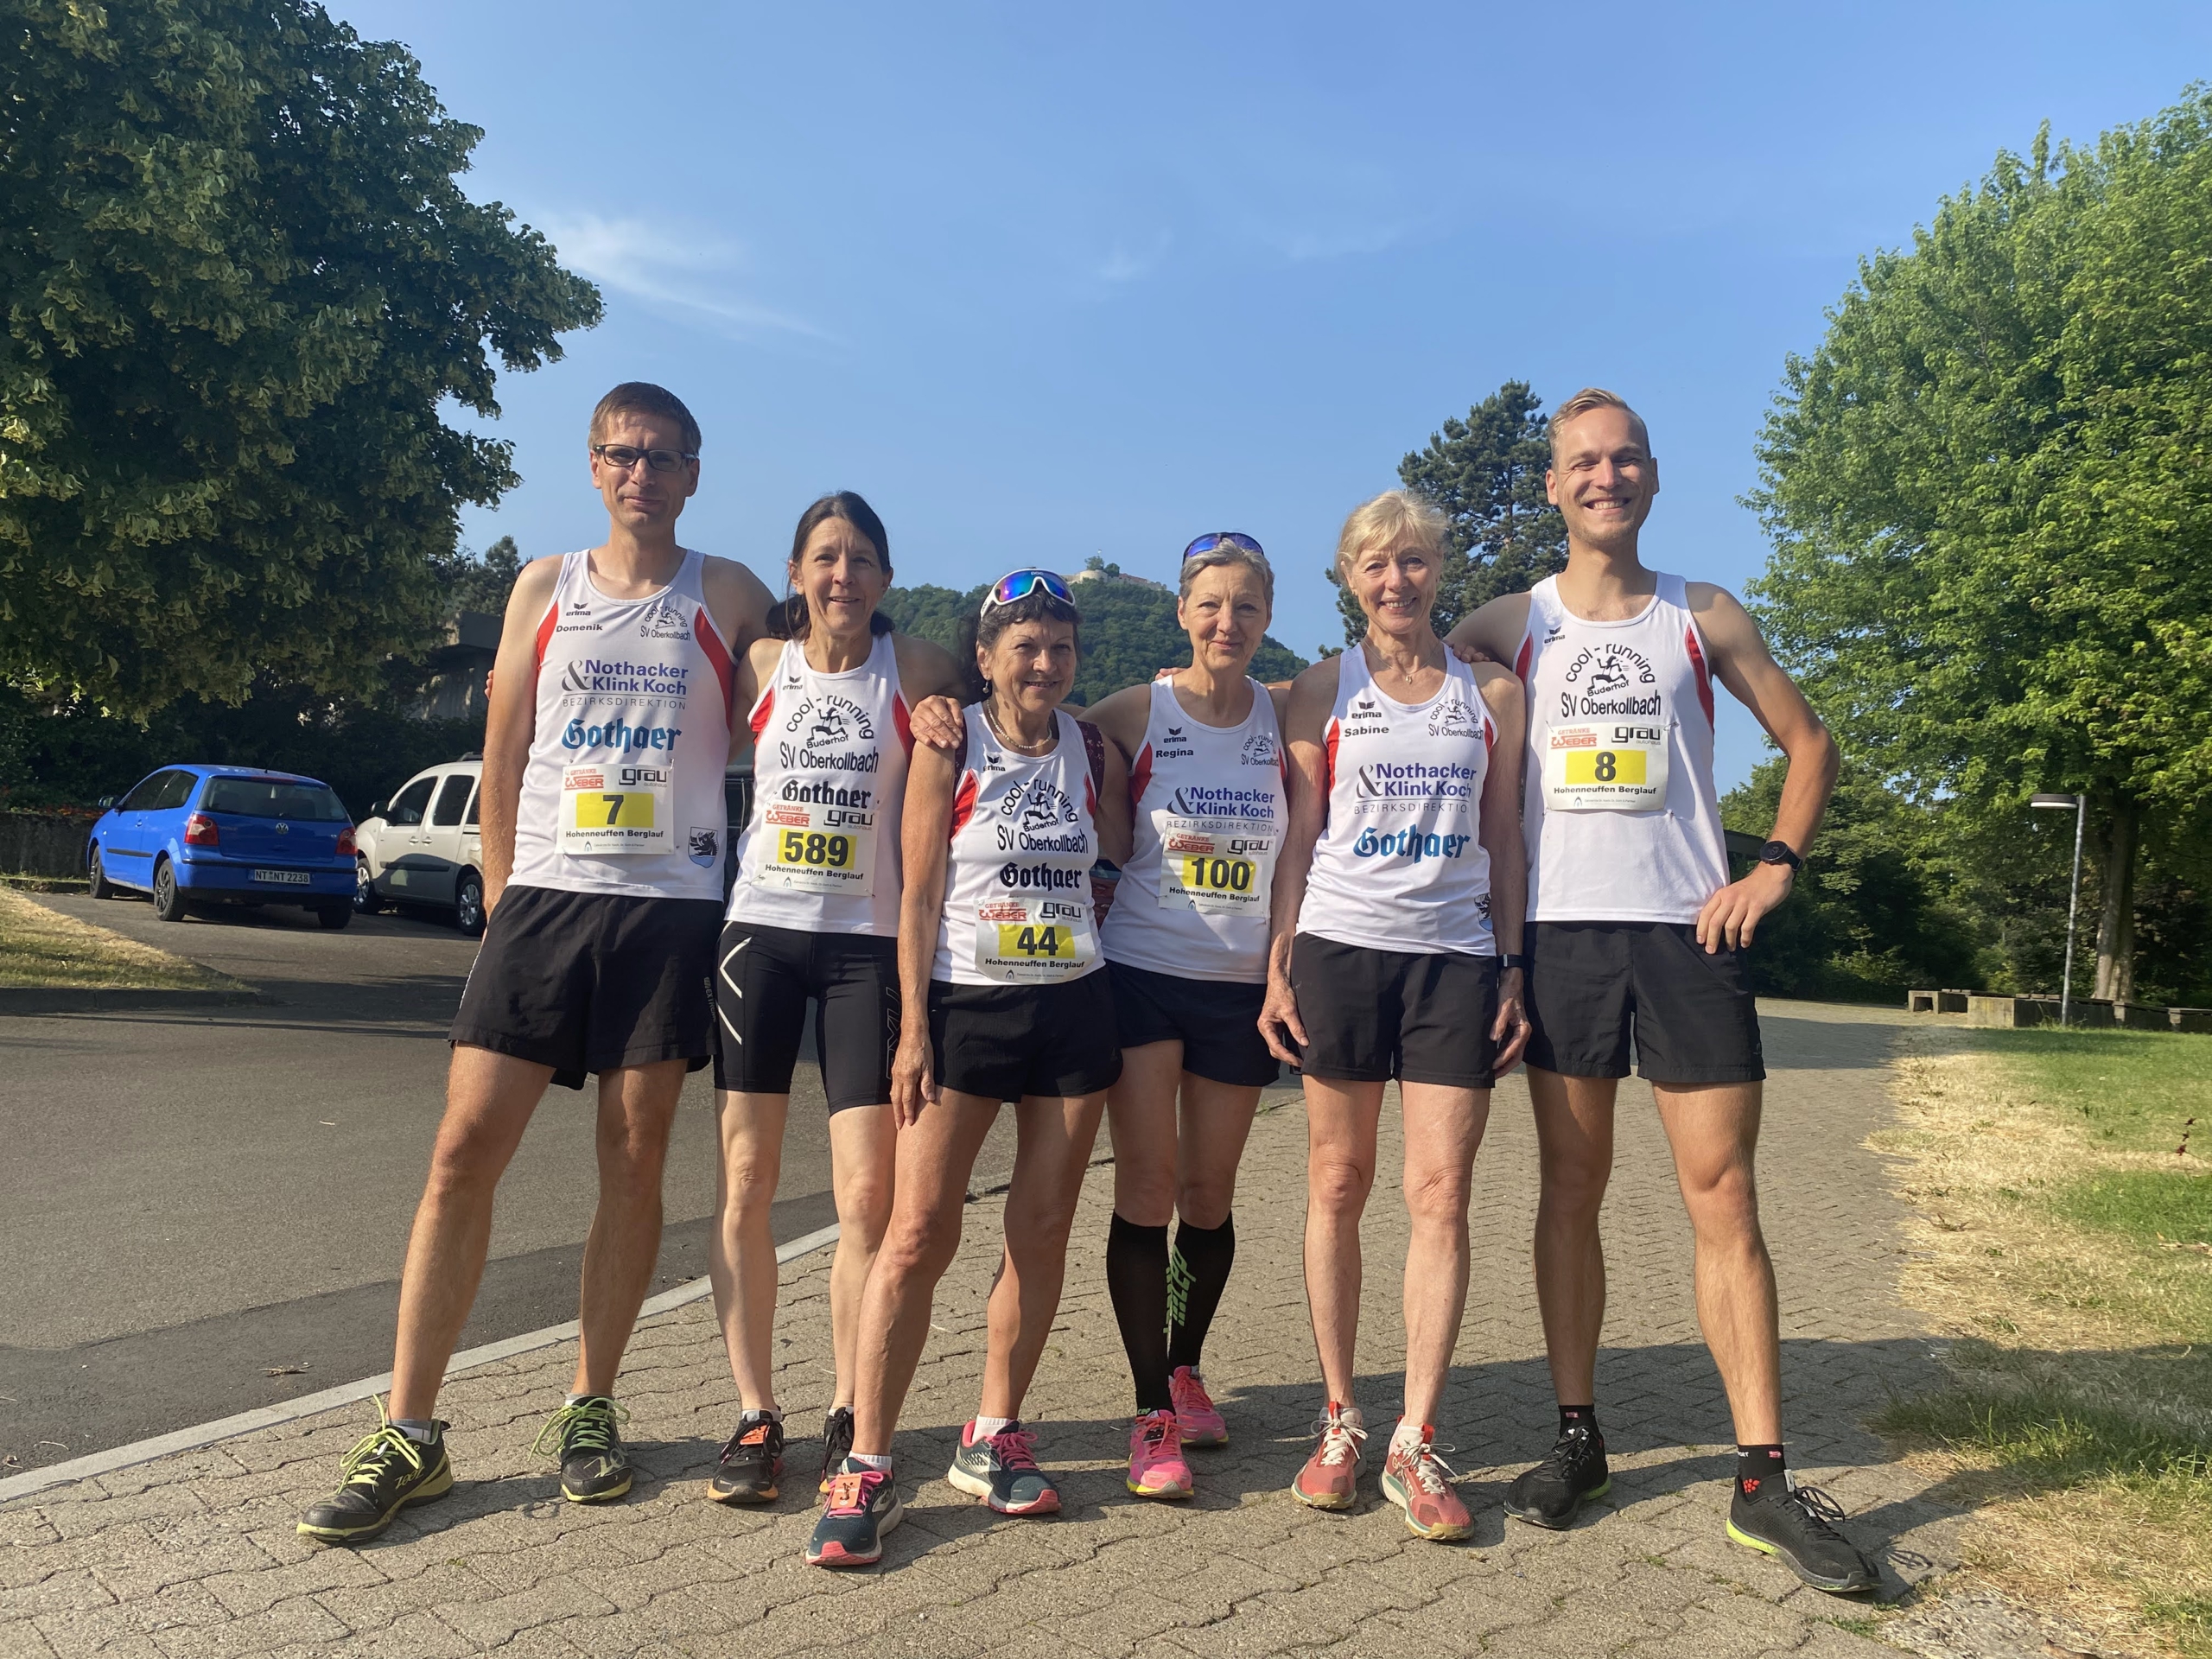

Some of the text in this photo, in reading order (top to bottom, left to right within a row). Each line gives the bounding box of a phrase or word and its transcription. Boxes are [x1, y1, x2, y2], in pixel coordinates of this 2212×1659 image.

[556, 624, 603, 632] Domenik
[640, 625, 690, 641] SV Oberkollbach
[1544, 634, 1566, 644] erima
[585, 659, 688, 678] Nothacker
[1566, 647, 1593, 683] cool
[1606, 644, 1656, 683] running
[562, 659, 592, 691] &
[592, 677, 687, 695] Klink Koch
[1587, 679, 1630, 696] Buderhof
[563, 697, 686, 709] BEZIRKSDIREKTION
[1561, 690, 1661, 718] SV Oberkollbach
[786, 697, 814, 732] cool
[827, 695, 874, 740] running
[562, 717, 682, 753] Gothaer
[1344, 726, 1389, 737] Sabine
[1428, 723, 1439, 736] SV
[1441, 727, 1484, 741] Oberkollbach
[1611, 727, 1660, 743] grau
[806, 734, 849, 749] Buderhof
[780, 741, 879, 773] SV Oberkollbach
[1155, 748, 1194, 759] Regina
[1242, 753, 1249, 765] SV
[1376, 763, 1477, 780] Nothacker
[1594, 752, 1616, 782] 8
[619, 769, 666, 785] grau
[1357, 765, 1383, 798] &
[782, 779, 871, 809] Gothaer
[1191, 787, 1274, 803] Nothacker
[1385, 781, 1471, 798] Klink Koch
[1618, 786, 1656, 795] Berglauf
[1001, 780, 1025, 816] cool
[1033, 779, 1078, 823] running
[1167, 787, 1195, 814] &
[1354, 803, 1467, 815] BEZIRKSDIREKTIO
[602, 795, 624, 825] 7
[823, 810, 873, 827] grau
[1196, 802, 1274, 818] Klink Koch
[1023, 818, 1059, 832] Buderhof
[1167, 821, 1273, 832] BEZIRKSDIREKTION
[627, 830, 664, 838] Berglauf
[997, 824, 1088, 854] SV Oberkollbach
[785, 831, 849, 867] 589
[1227, 840, 1269, 855] grau
[1353, 823, 1471, 864] Gothaer
[256, 871, 308, 882] NT NT 2238
[765, 864, 863, 880] Hohenneuffen Berglauf
[1000, 861, 1082, 892] Gothaer
[1192, 857, 1249, 890] 100
[1169, 887, 1260, 903] Hohenneuffen Berglauf
[1040, 902, 1081, 918] grau
[1017, 926, 1058, 956] 44
[985, 958, 1084, 969] Hohenneuffen Berglauf
